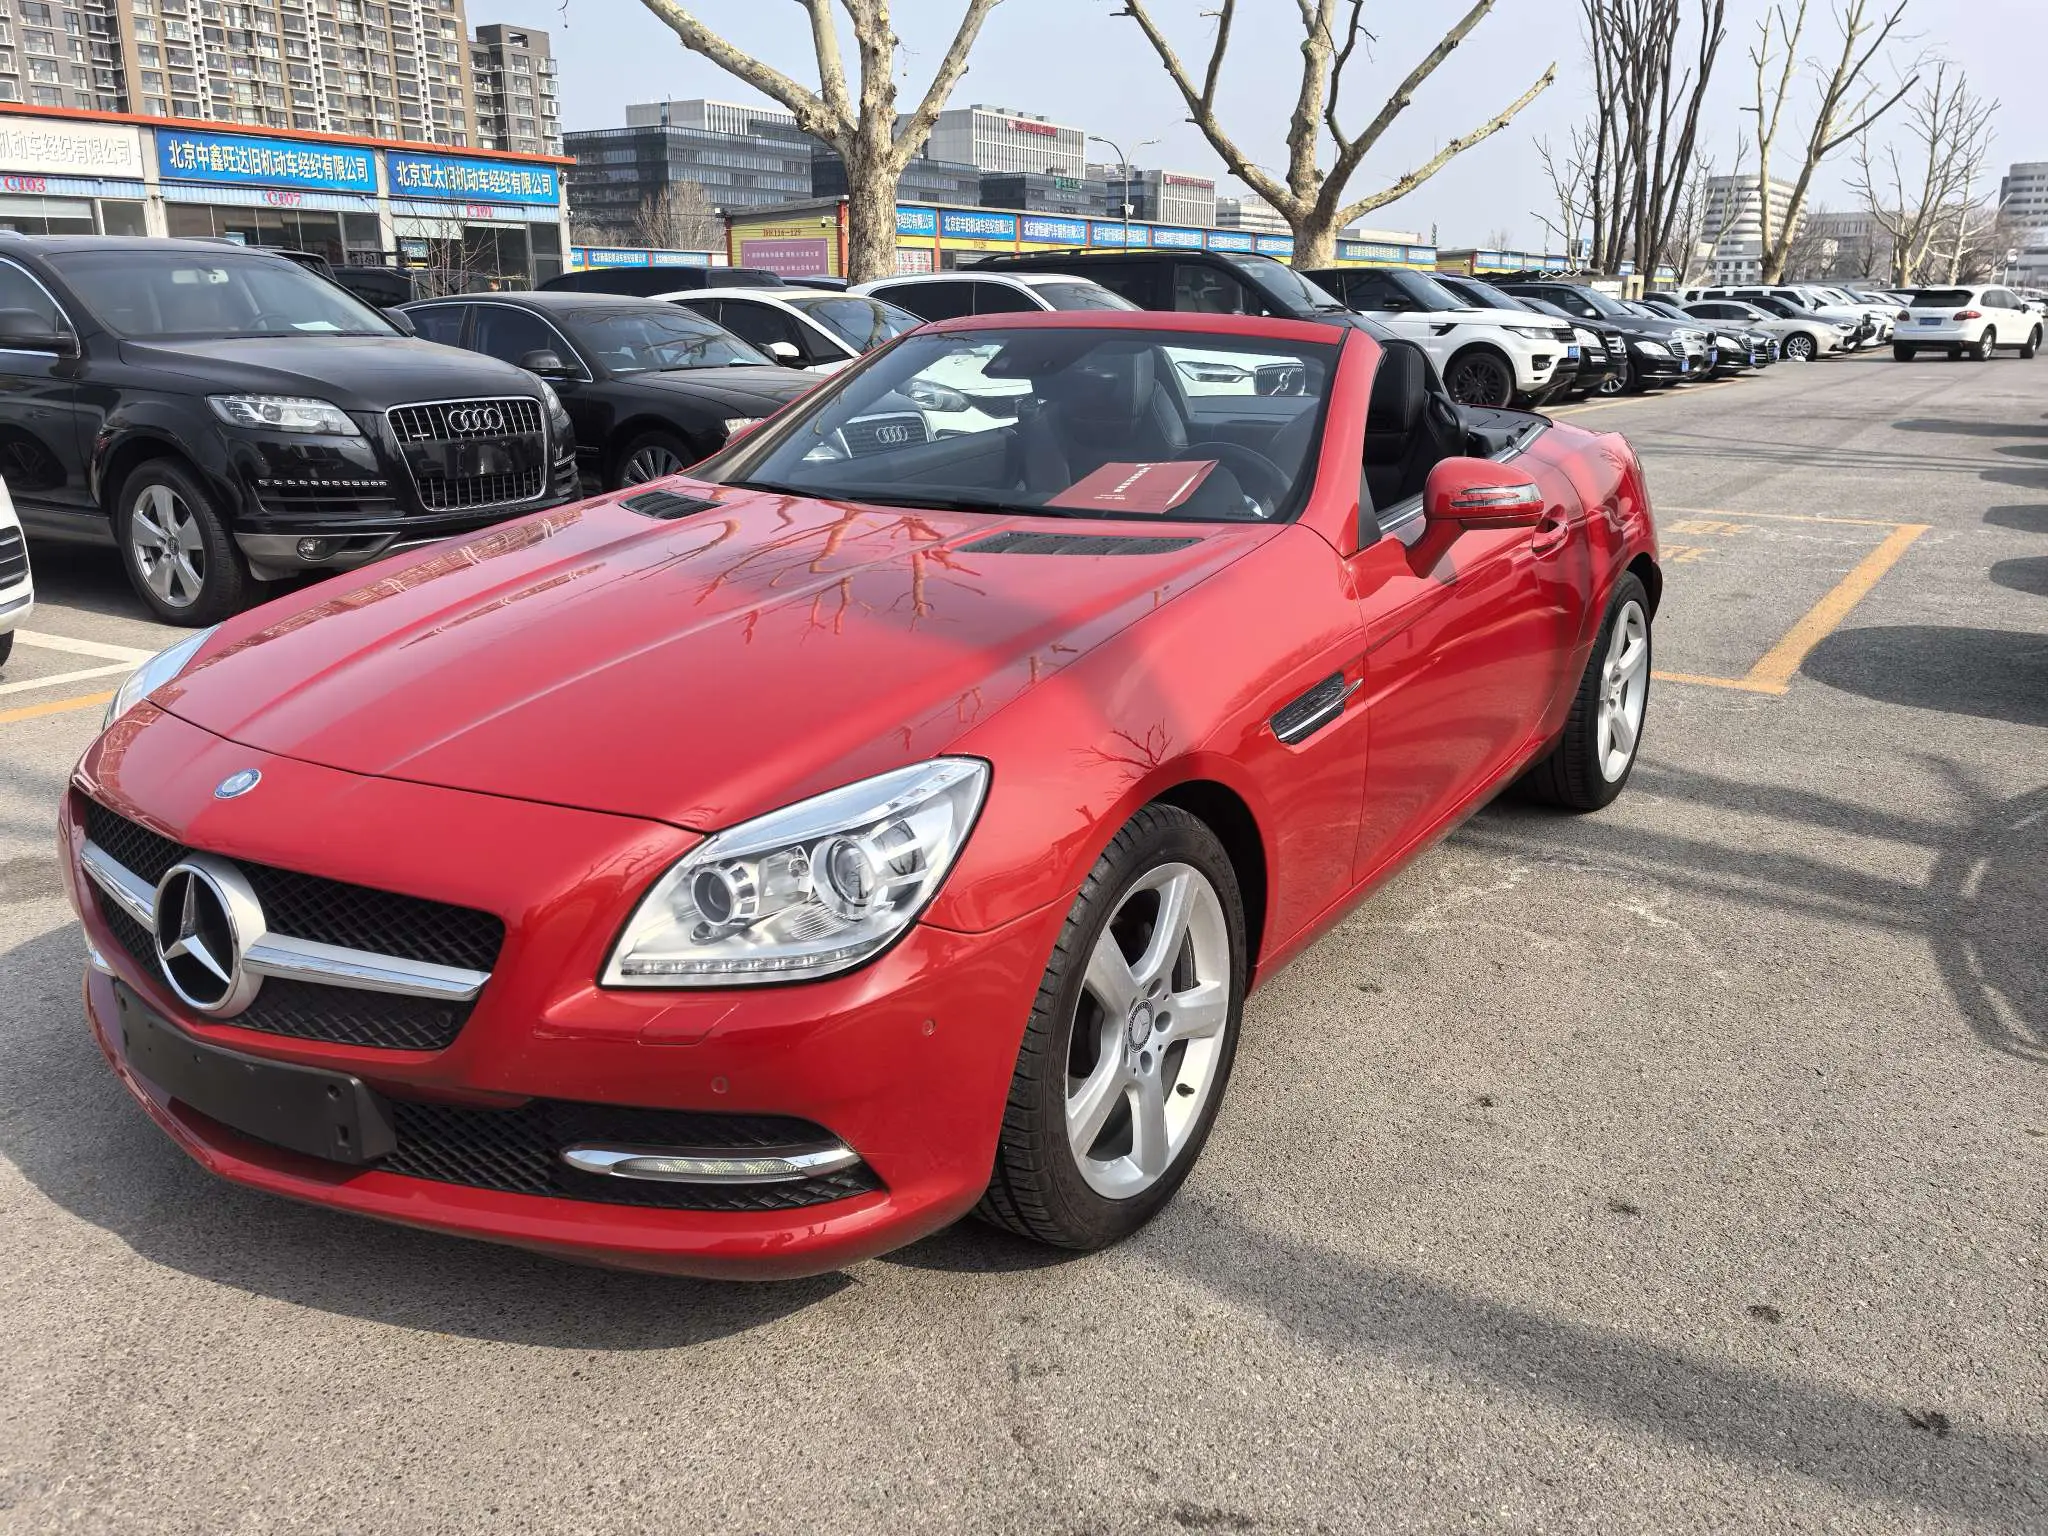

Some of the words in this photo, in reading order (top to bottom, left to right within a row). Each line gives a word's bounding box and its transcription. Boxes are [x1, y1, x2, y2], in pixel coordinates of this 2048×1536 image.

[168, 139, 369, 183] 北京中鑫旺达旧机动车经纪有限公司
[4, 176, 46, 192] C103
[396, 160, 553, 197] 北京亚太旧机动车经纪有限公司
[266, 190, 301, 206] C107
